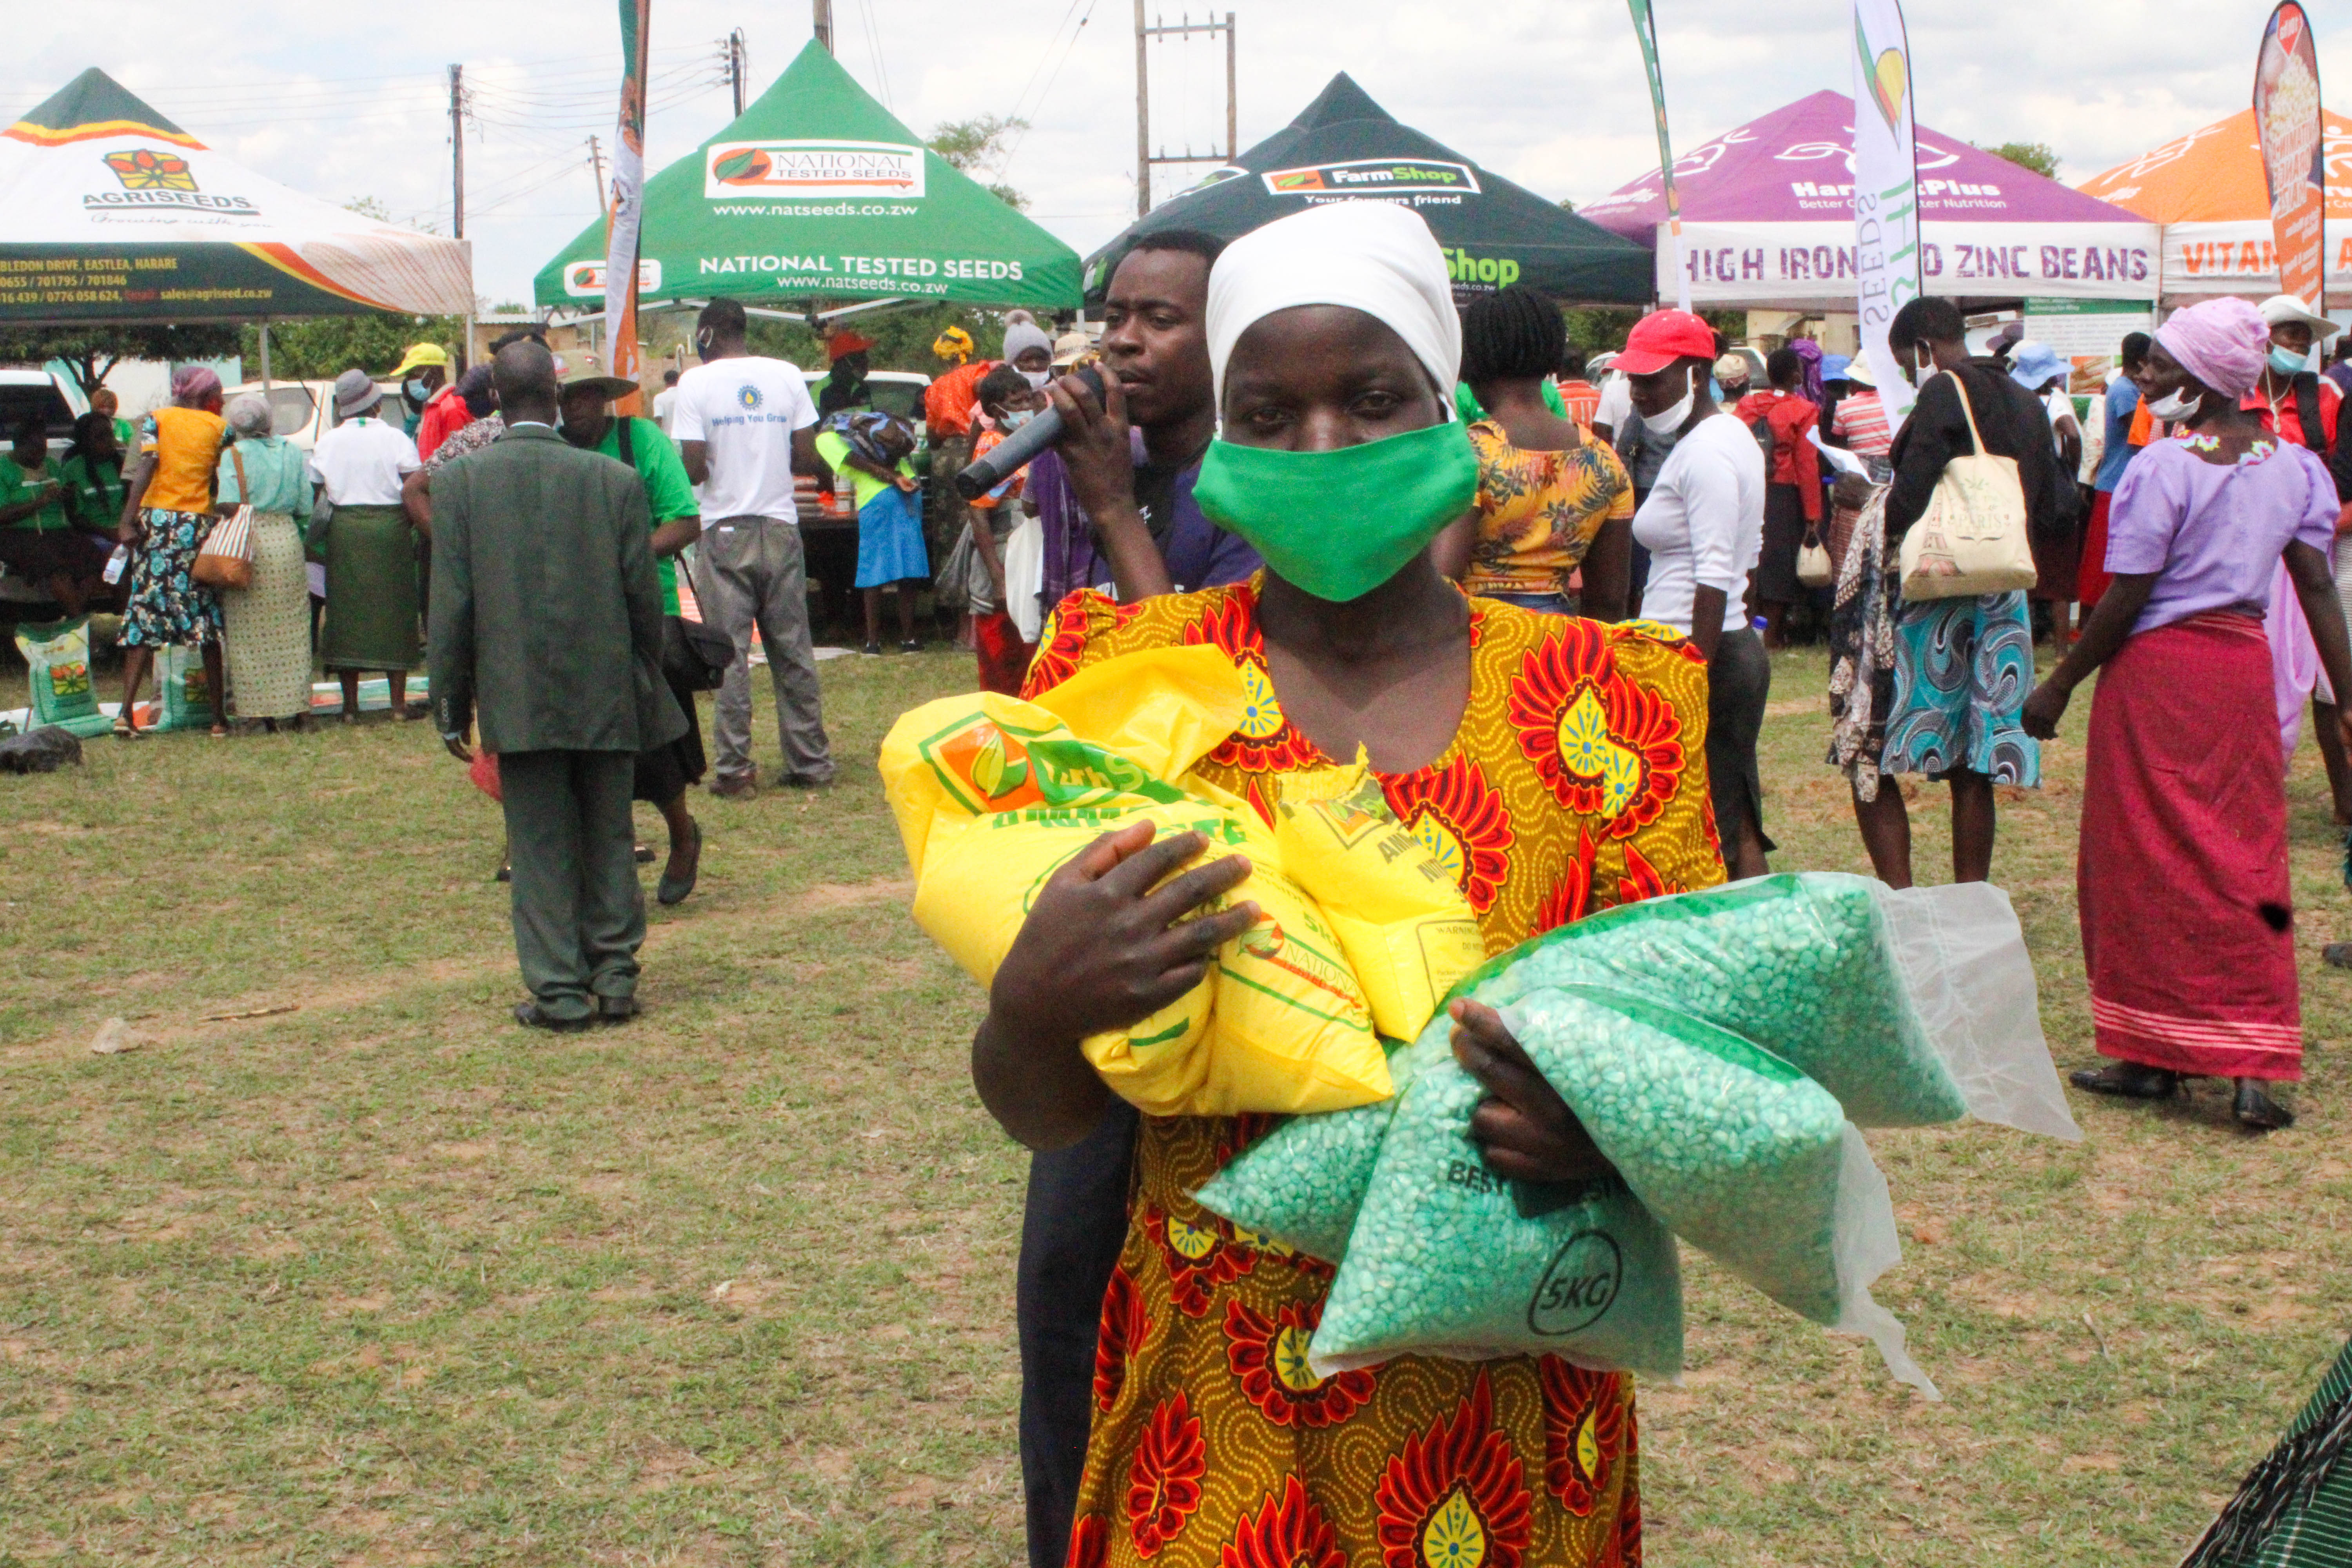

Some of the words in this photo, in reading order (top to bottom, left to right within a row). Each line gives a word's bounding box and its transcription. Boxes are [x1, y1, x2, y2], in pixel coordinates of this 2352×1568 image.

[778, 154, 906, 169] NATIONAL
[777, 169, 846, 178] TESTED
[857, 169, 911, 178] SEEDS
[1332, 167, 1457, 183] FarmShop
[83, 191, 253, 208] AGRISEEDS
[1413, 195, 1461, 207] friend
[1799, 200, 1843, 209] Better
[1944, 198, 2007, 208] Nutrition
[713, 203, 918, 216] www.natseeds.co.zw
[135, 258, 177, 269] HARARE
[700, 256, 833, 274] NATIONAL
[840, 256, 936, 276] TESTED
[943, 260, 1023, 281] SEEDS
[1686, 248, 1764, 282] HIGH
[1780, 245, 1858, 279] IRON
[1954, 243, 2030, 278] ZINC
[2040, 245, 2148, 281] BEANS
[777, 275, 948, 294] www.natseeds.co.zw
[1451, 282, 1496, 291] eeds.co.zw
[712, 415, 744, 426] Helping
[1539, 1272, 1610, 1310] 5KG
